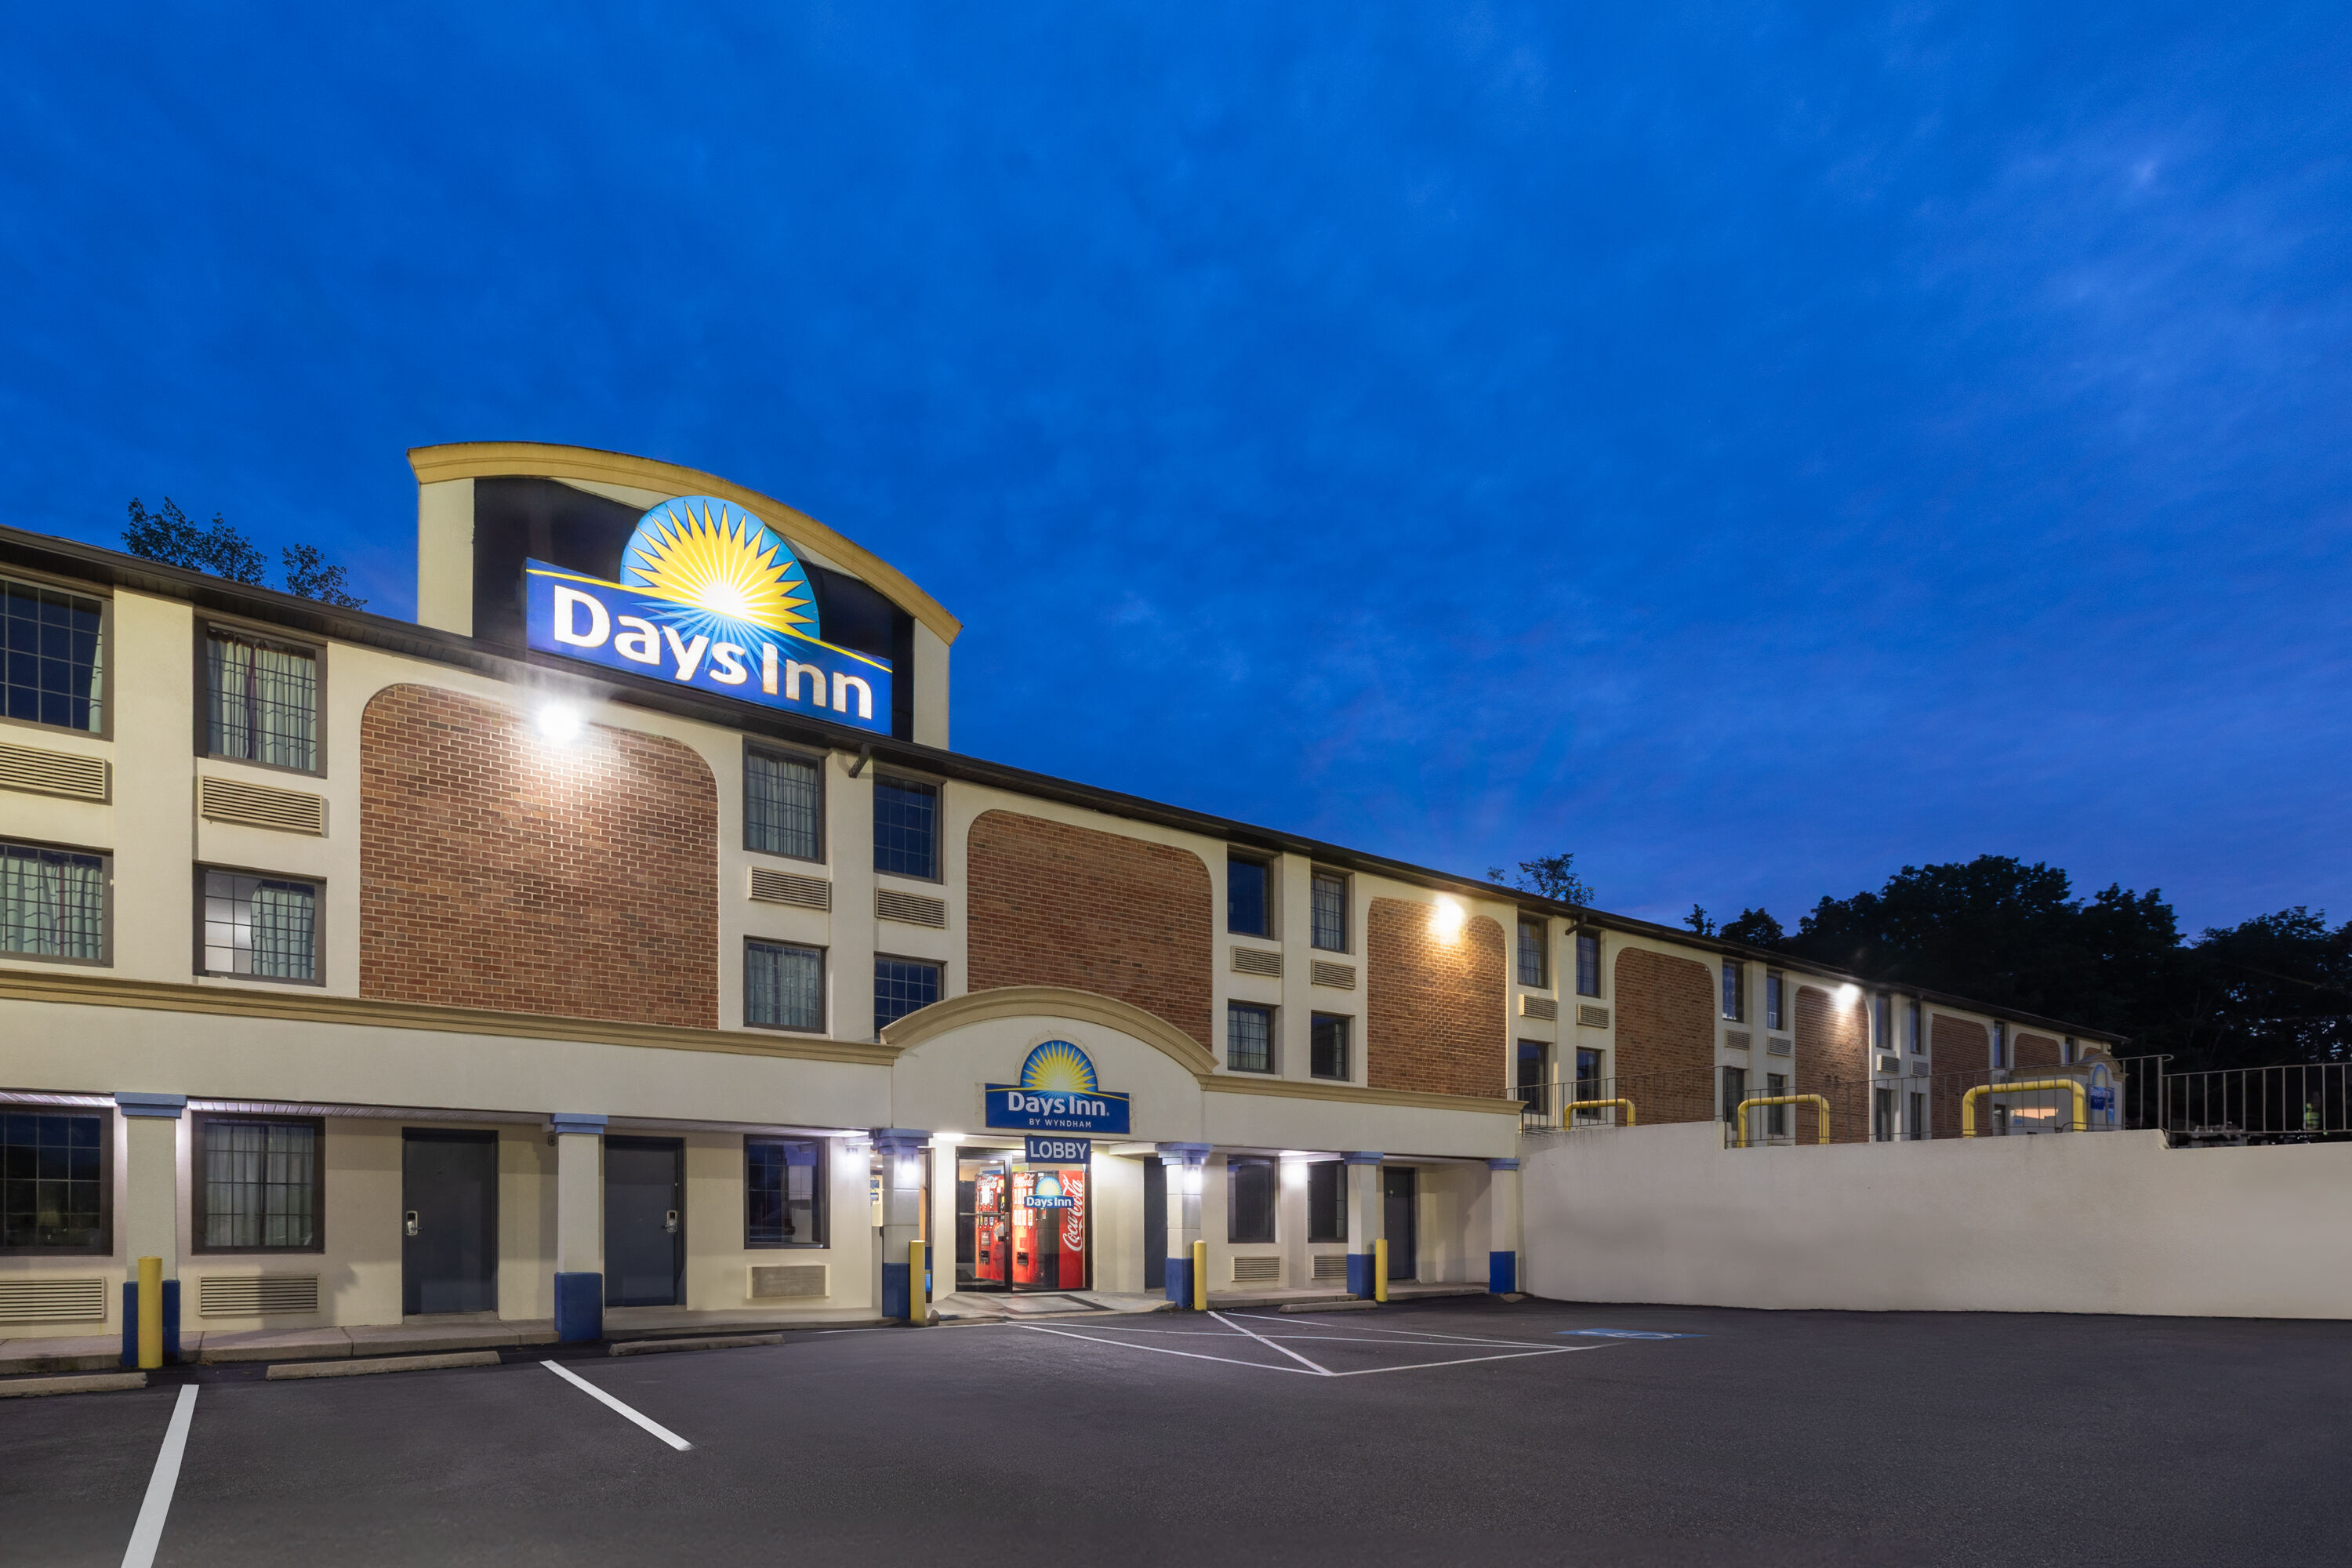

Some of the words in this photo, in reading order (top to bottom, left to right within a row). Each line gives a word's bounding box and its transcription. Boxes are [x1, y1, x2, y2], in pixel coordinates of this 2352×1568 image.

[554, 584, 749, 686] Days
[762, 641, 873, 720] Inn
[1008, 1091, 1065, 1116] Days
[1069, 1095, 1105, 1116] Inn
[1044, 1119, 1091, 1128] WYNDHAM
[1029, 1141, 1087, 1160] LOBBY
[1026, 1196, 1053, 1208] Days
[1054, 1196, 1072, 1207] Inn
